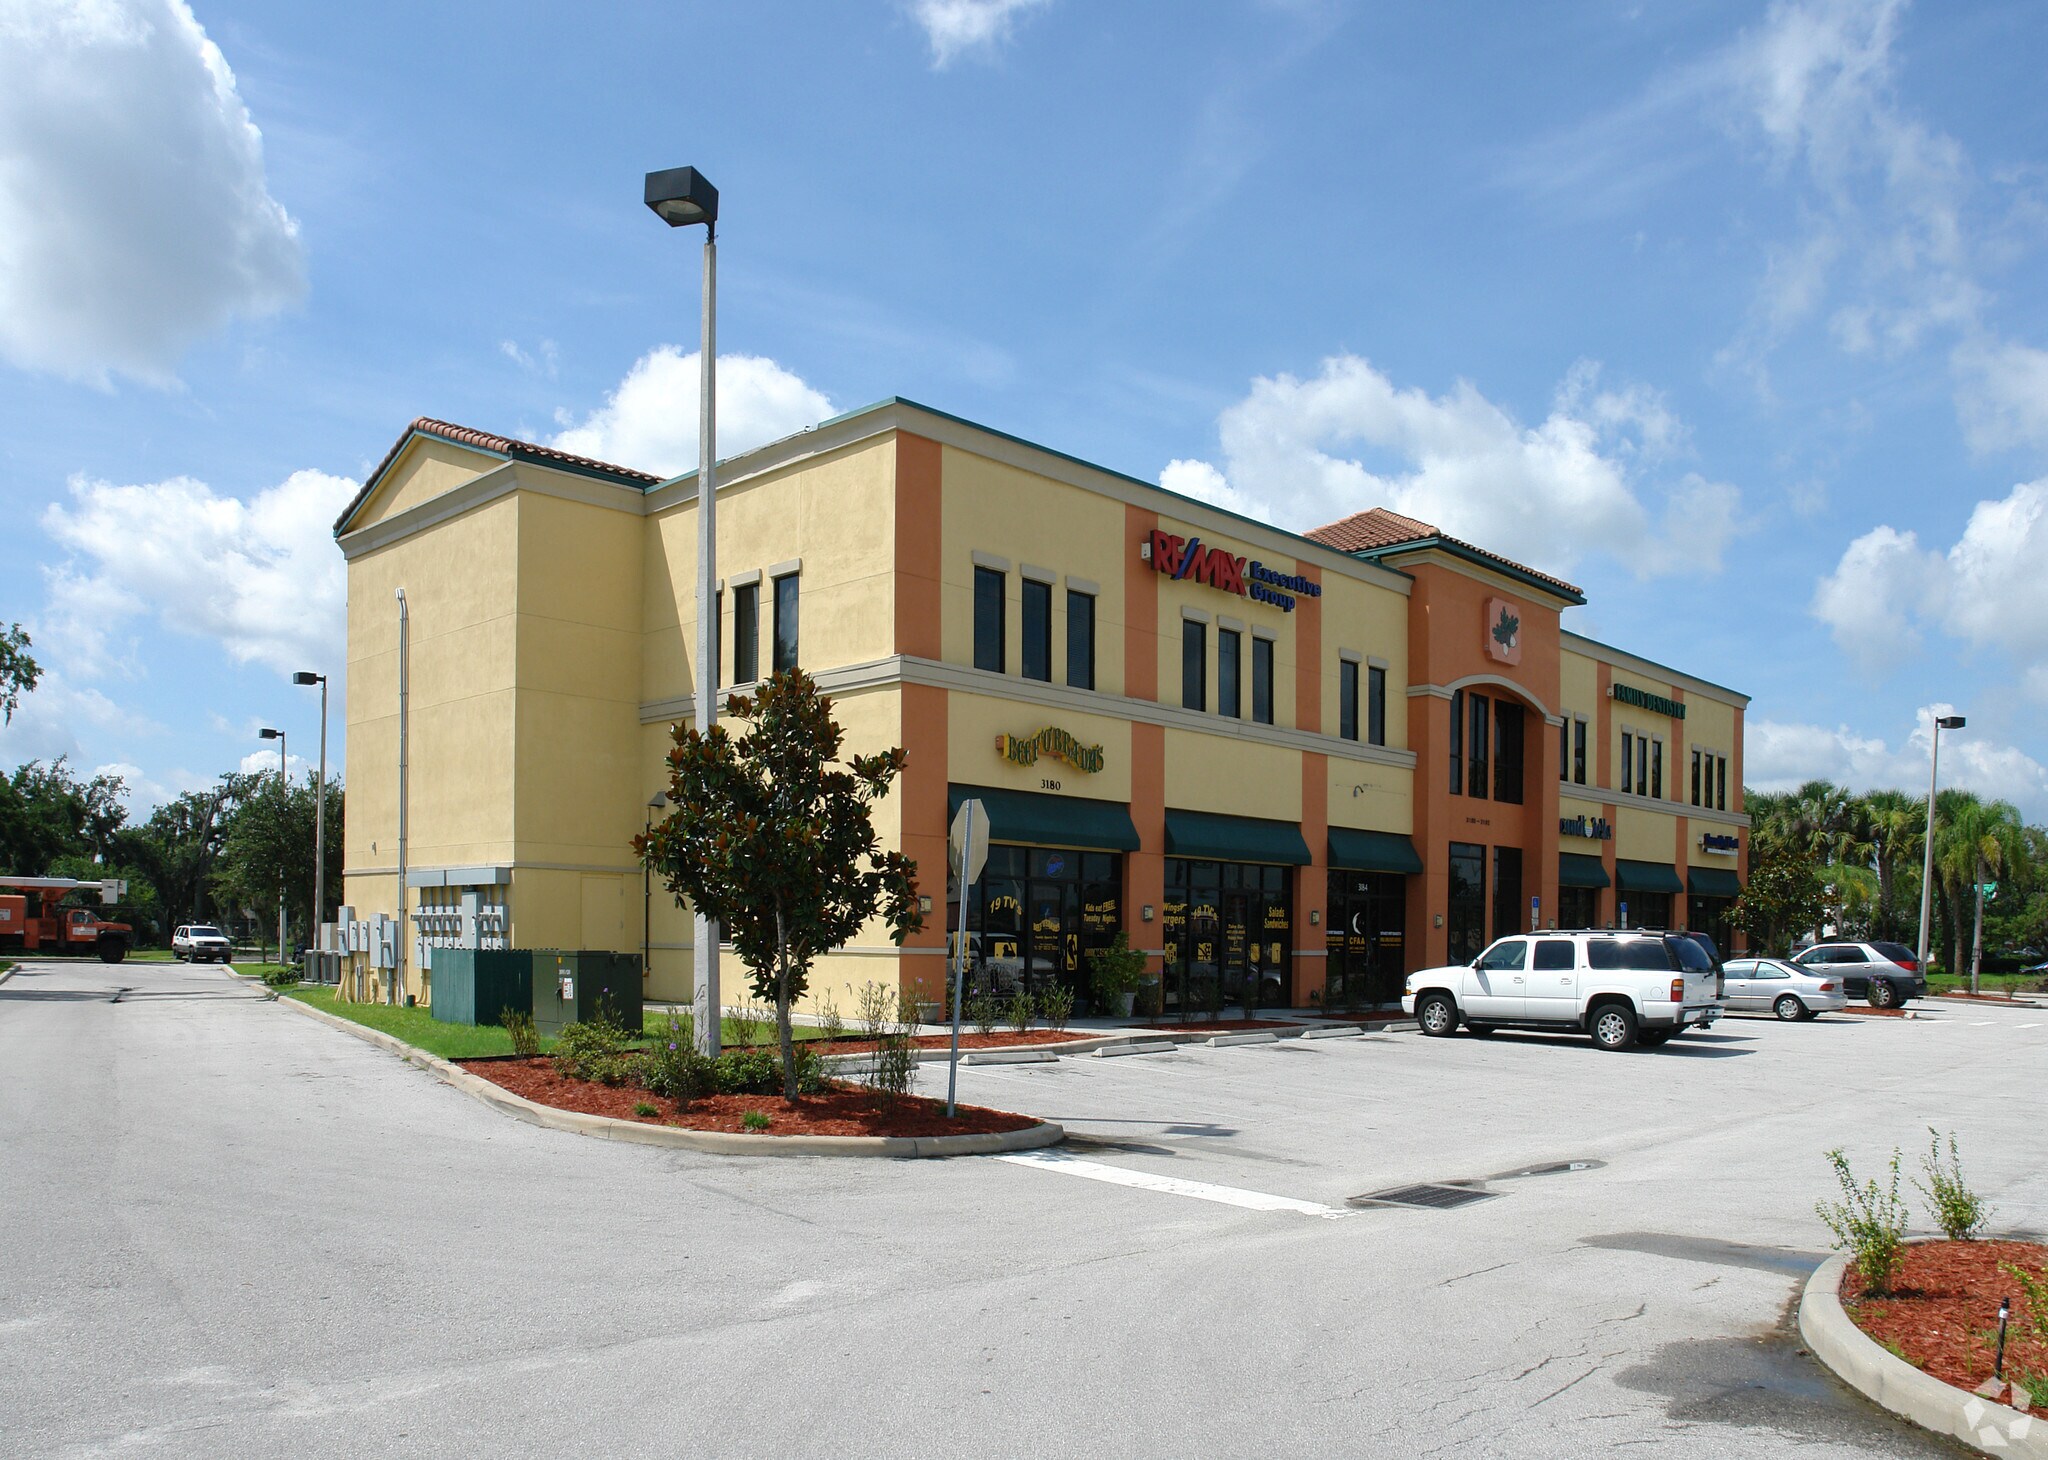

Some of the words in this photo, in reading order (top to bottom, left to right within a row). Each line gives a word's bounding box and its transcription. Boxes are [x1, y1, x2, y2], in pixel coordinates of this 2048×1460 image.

[1151, 529, 1247, 597] RE/MAX
[1250, 560, 1322, 597] Executive
[1250, 581, 1295, 612] Group
[1614, 683, 1647, 709] FAMILY
[1646, 692, 1686, 720] DENTISTRY
[1040, 779, 1061, 791] 3180
[1163, 915, 1186, 927] urgers
[1268, 906, 1285, 918] Salads
[1349, 936, 1365, 945] CFAA
